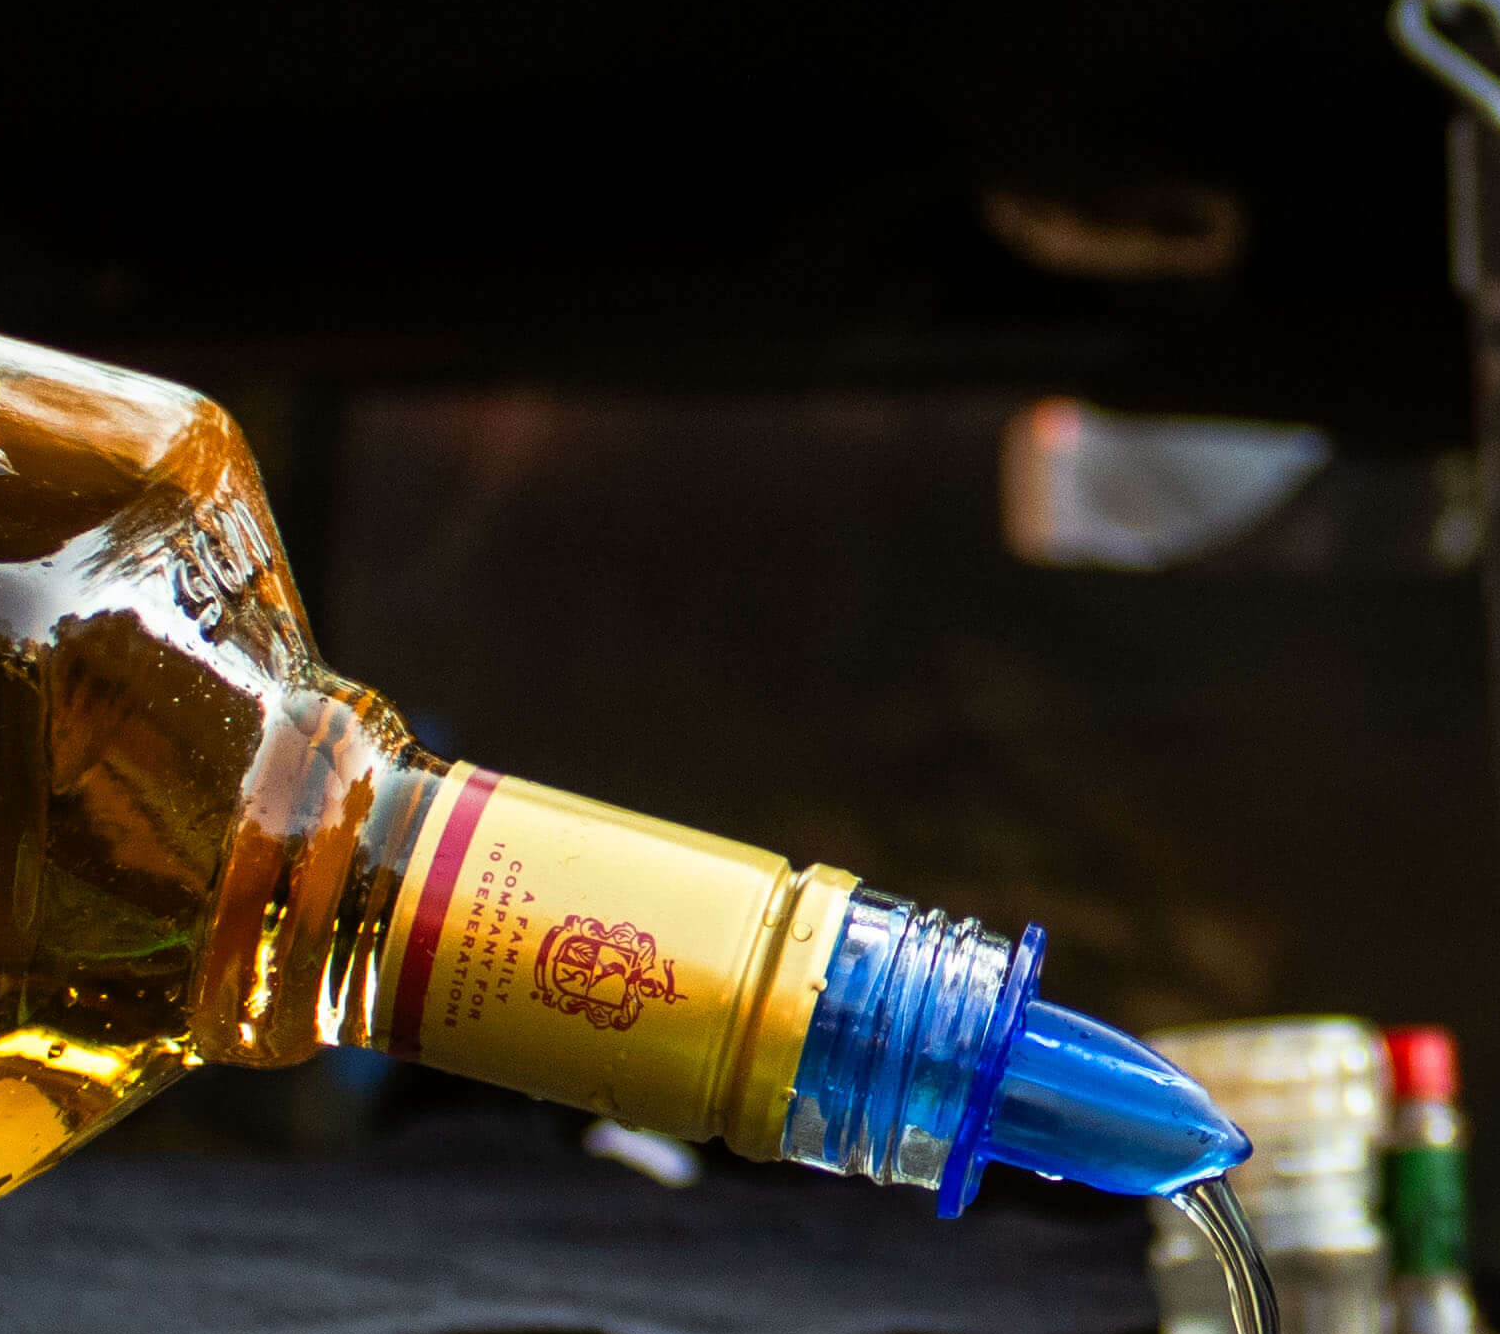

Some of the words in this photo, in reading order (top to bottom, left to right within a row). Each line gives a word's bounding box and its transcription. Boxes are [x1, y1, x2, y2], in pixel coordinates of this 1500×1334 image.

[489, 842, 505, 862] 10
[478, 859, 522, 972] COMPANY
[522, 890, 535, 903] A
[444, 872, 493, 1028] GENERATIONS
[493, 915, 528, 1005] FAMILY
[466, 979, 489, 1022] FOR
